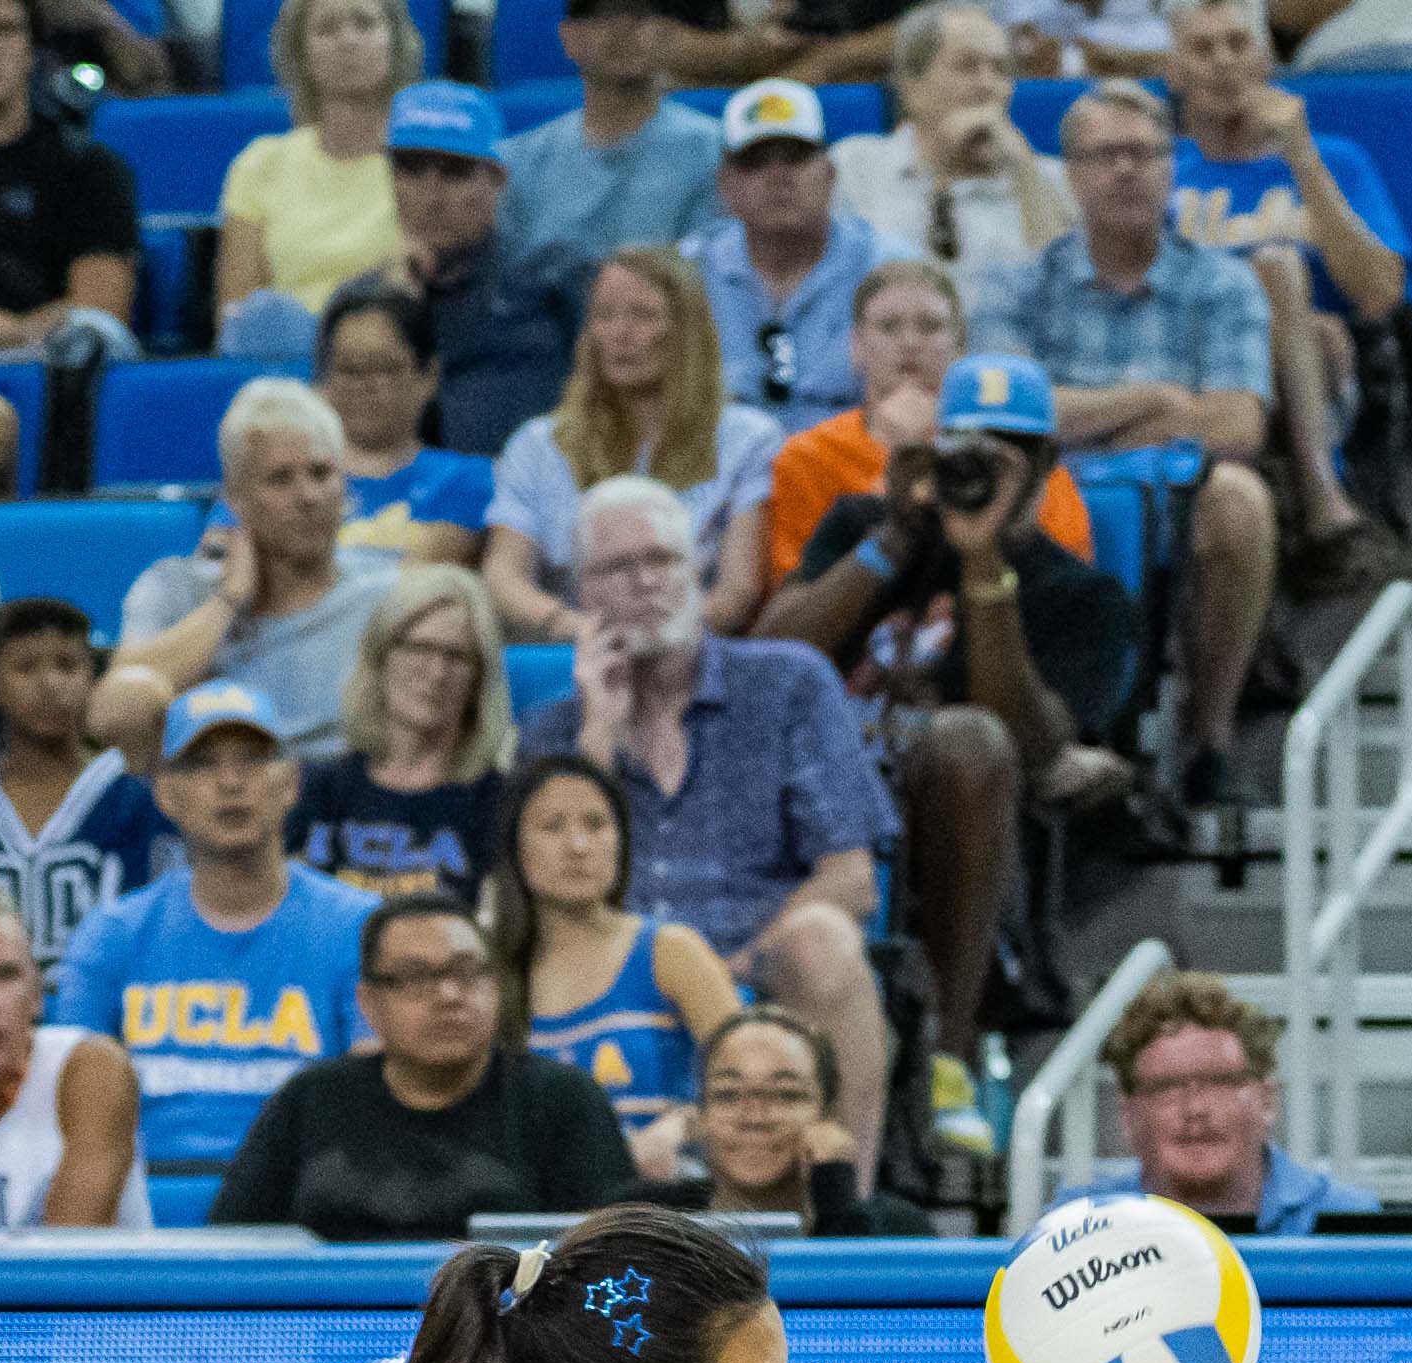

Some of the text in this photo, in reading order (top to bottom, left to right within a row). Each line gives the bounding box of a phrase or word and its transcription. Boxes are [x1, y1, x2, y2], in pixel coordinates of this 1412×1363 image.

[122, 980, 325, 1056] UCLA
[1048, 1216, 1112, 1252] Ucla
[1041, 1244, 1164, 1311] Wilson
